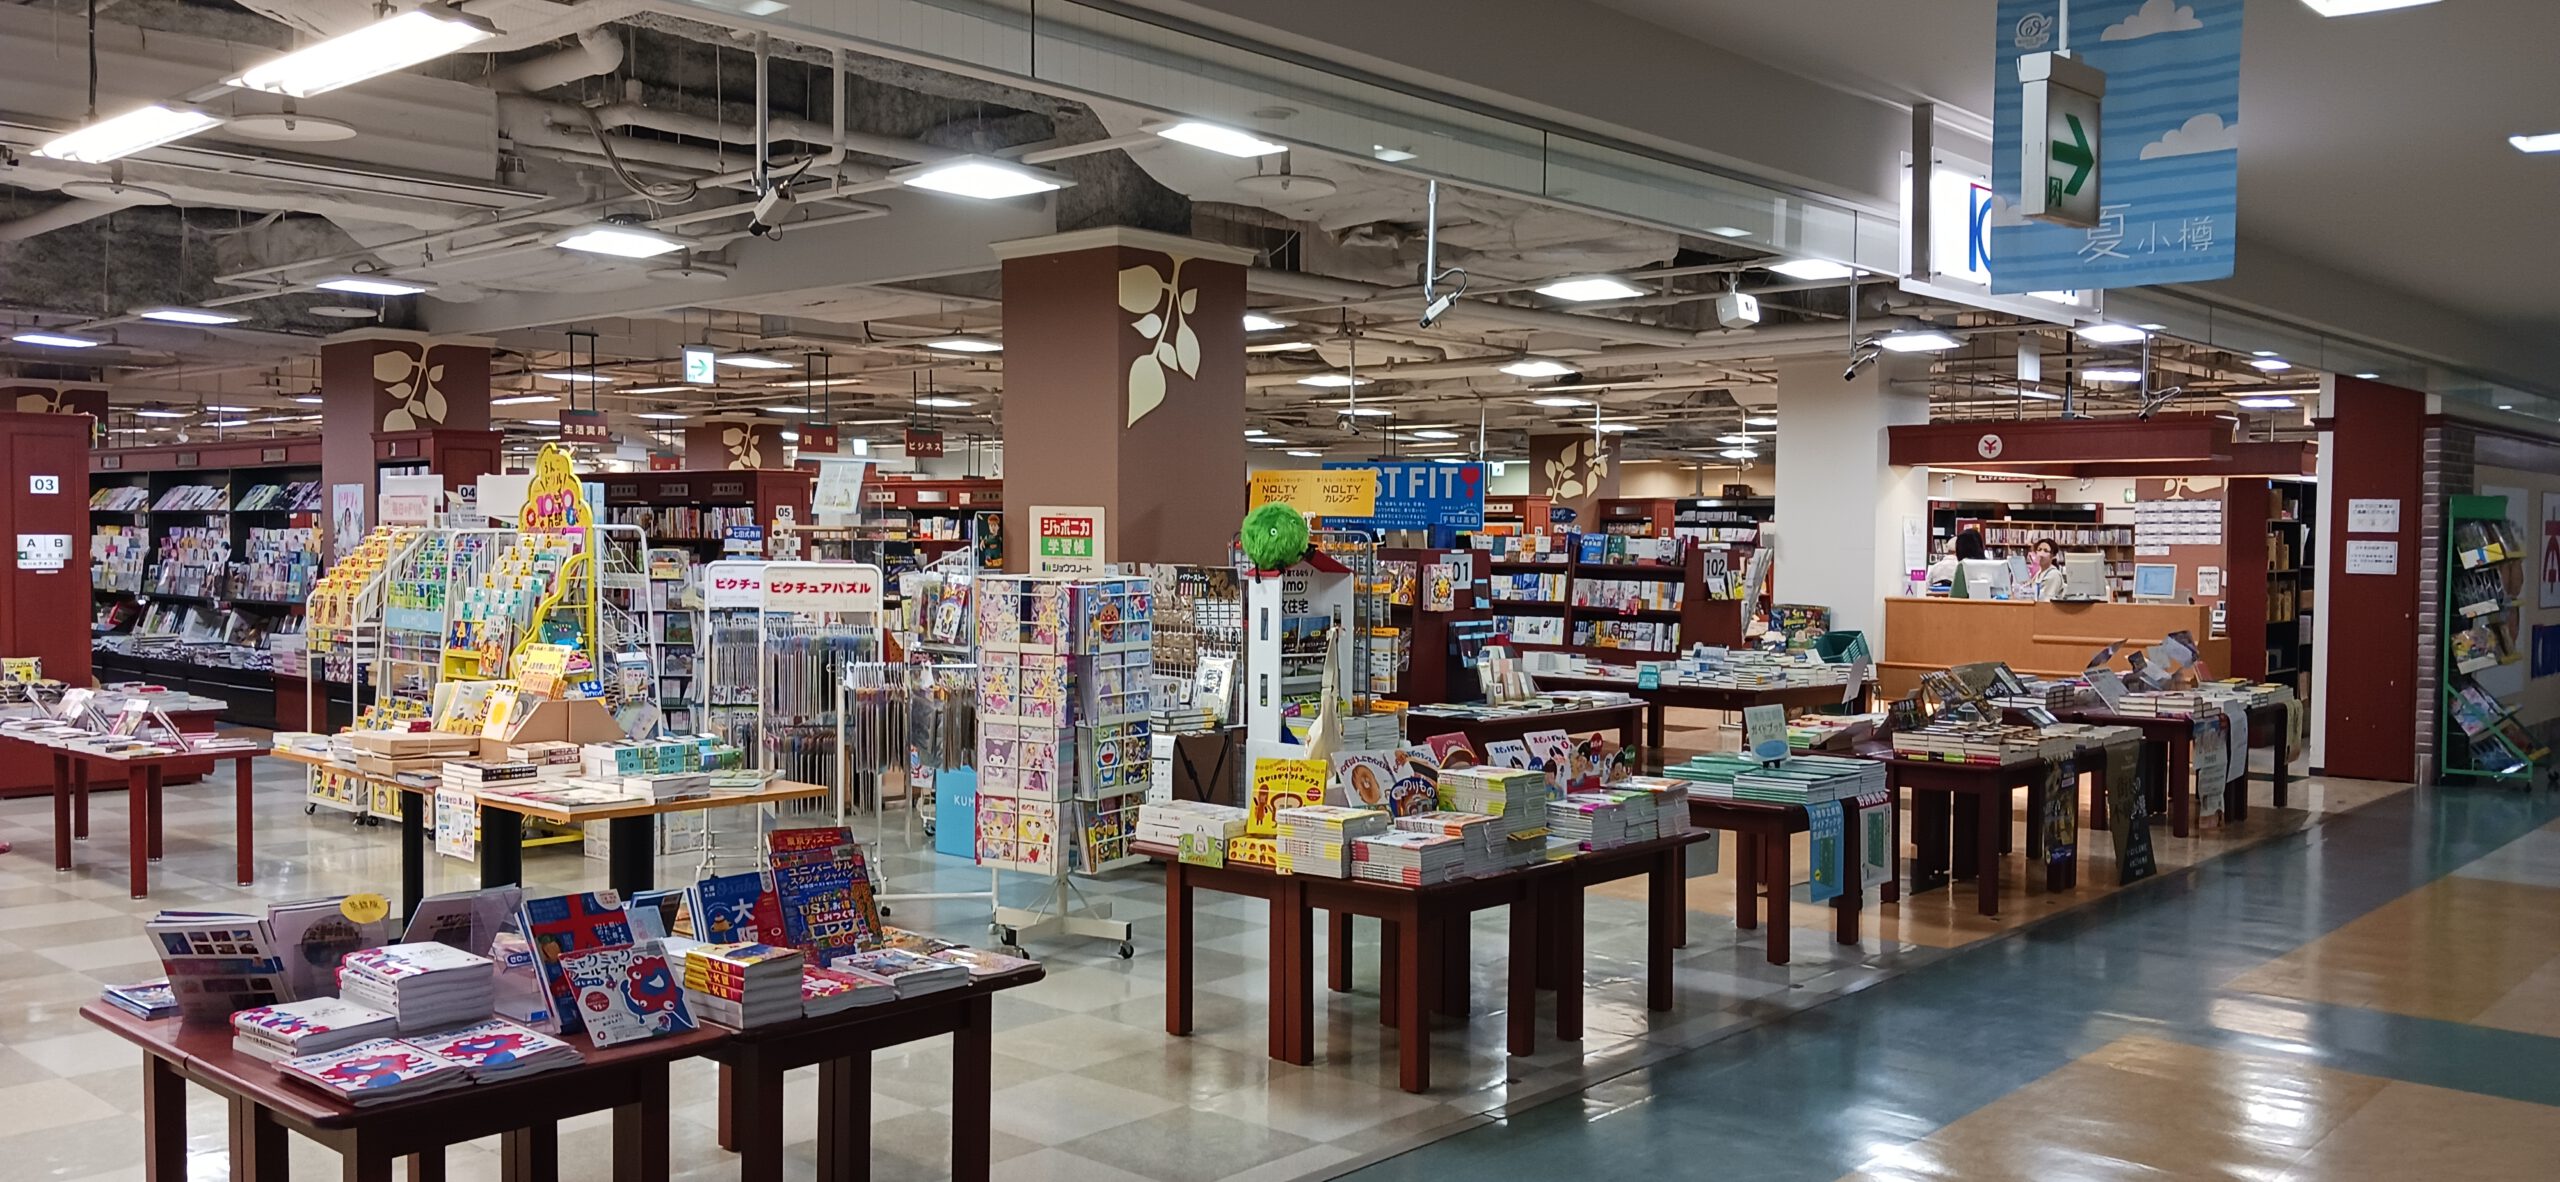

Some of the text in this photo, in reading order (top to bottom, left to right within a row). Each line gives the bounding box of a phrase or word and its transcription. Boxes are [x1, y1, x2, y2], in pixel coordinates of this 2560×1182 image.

[564, 424, 607, 436] 生活実用
[909, 441, 942, 452] ビジネス
[35, 479, 54, 491] 03
[1262, 485, 1298, 493] NOLTY
[1323, 485, 1361, 493] NOLTY
[461, 487, 475, 498] 04
[1264, 495, 1295, 503] カレンダー
[1325, 495, 1359, 503] カレンダー
[778, 507, 790, 517] 05
[1043, 519, 1090, 535] ジャポニカ
[27, 538, 63, 547] A B
[1048, 538, 1085, 555] 学習帳
[1445, 561, 1469, 582] 01
[1706, 558, 1725, 576] 102
[1180, 573, 1210, 581] パワーストーン
[771, 582, 871, 594] ピクチュアパズル
[788, 861, 854, 877] ユニバーサル
[731, 898, 759, 942] 大阪
[566, 950, 630, 971] ミャクミャク
[569, 964, 626, 980] シールブック
